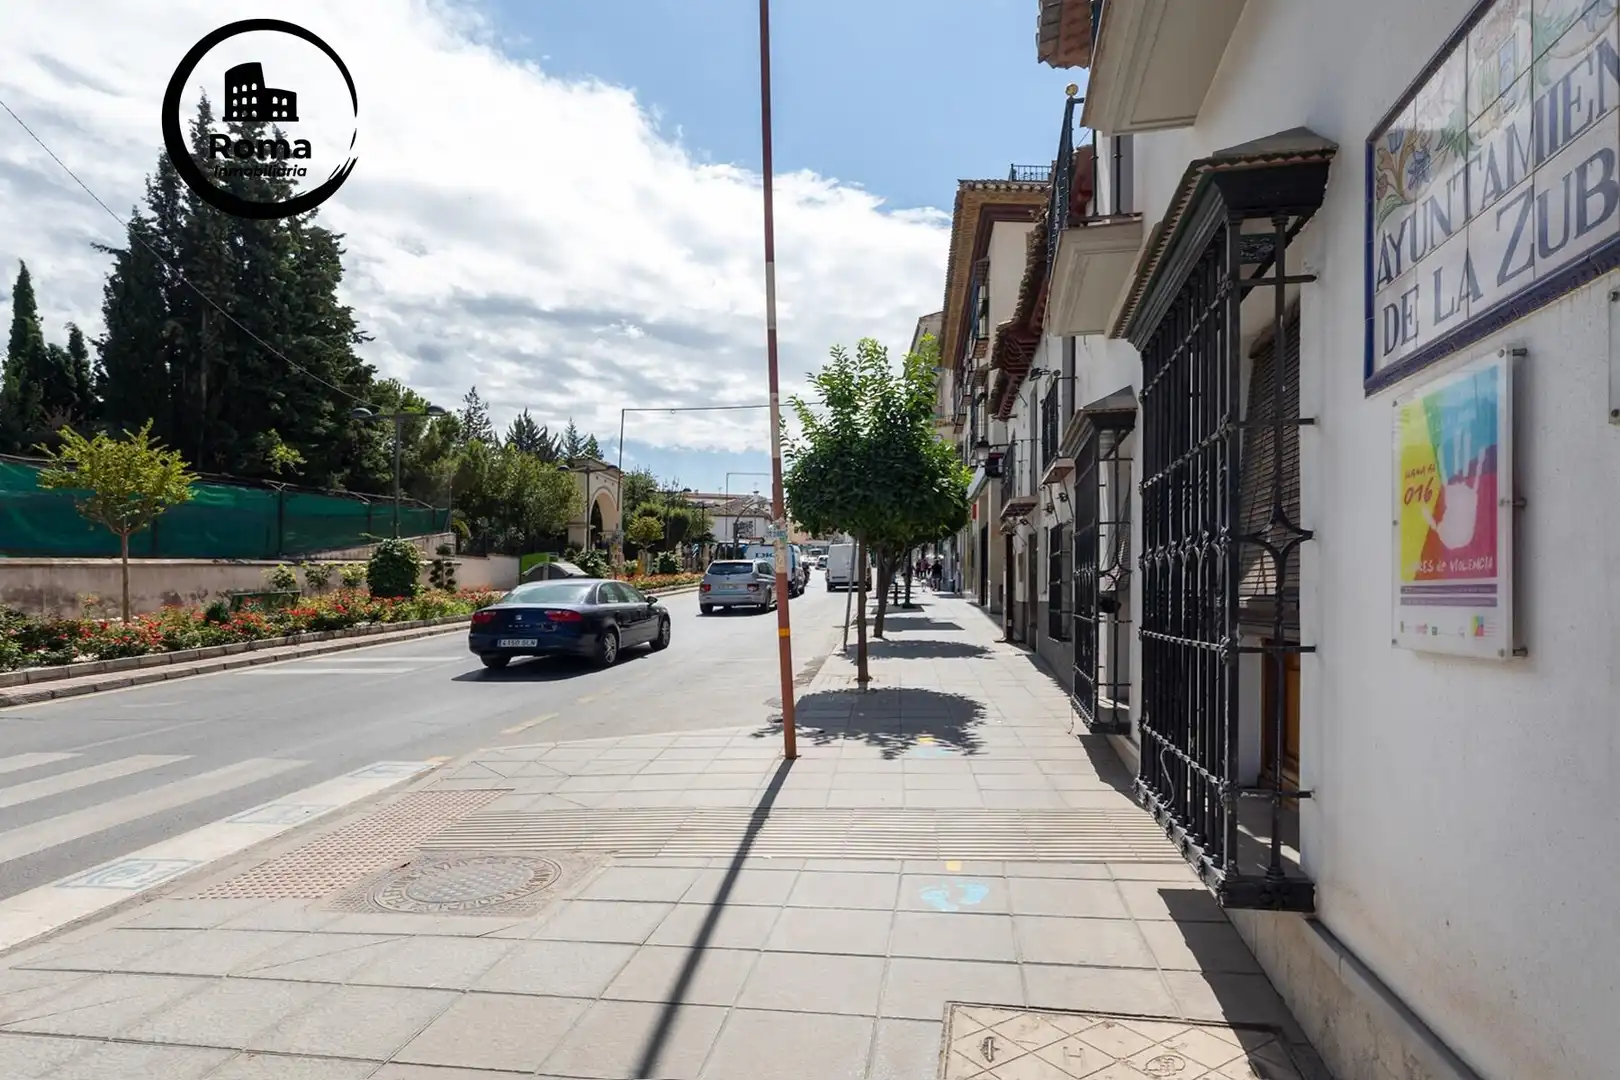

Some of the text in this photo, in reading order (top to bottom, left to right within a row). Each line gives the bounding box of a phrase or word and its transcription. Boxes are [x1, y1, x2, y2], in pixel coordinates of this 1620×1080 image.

[1383, 146, 1620, 357] DE LA ZUB
[1404, 477, 1433, 505] 016
[1450, 555, 1494, 572] VIOLENCIA
